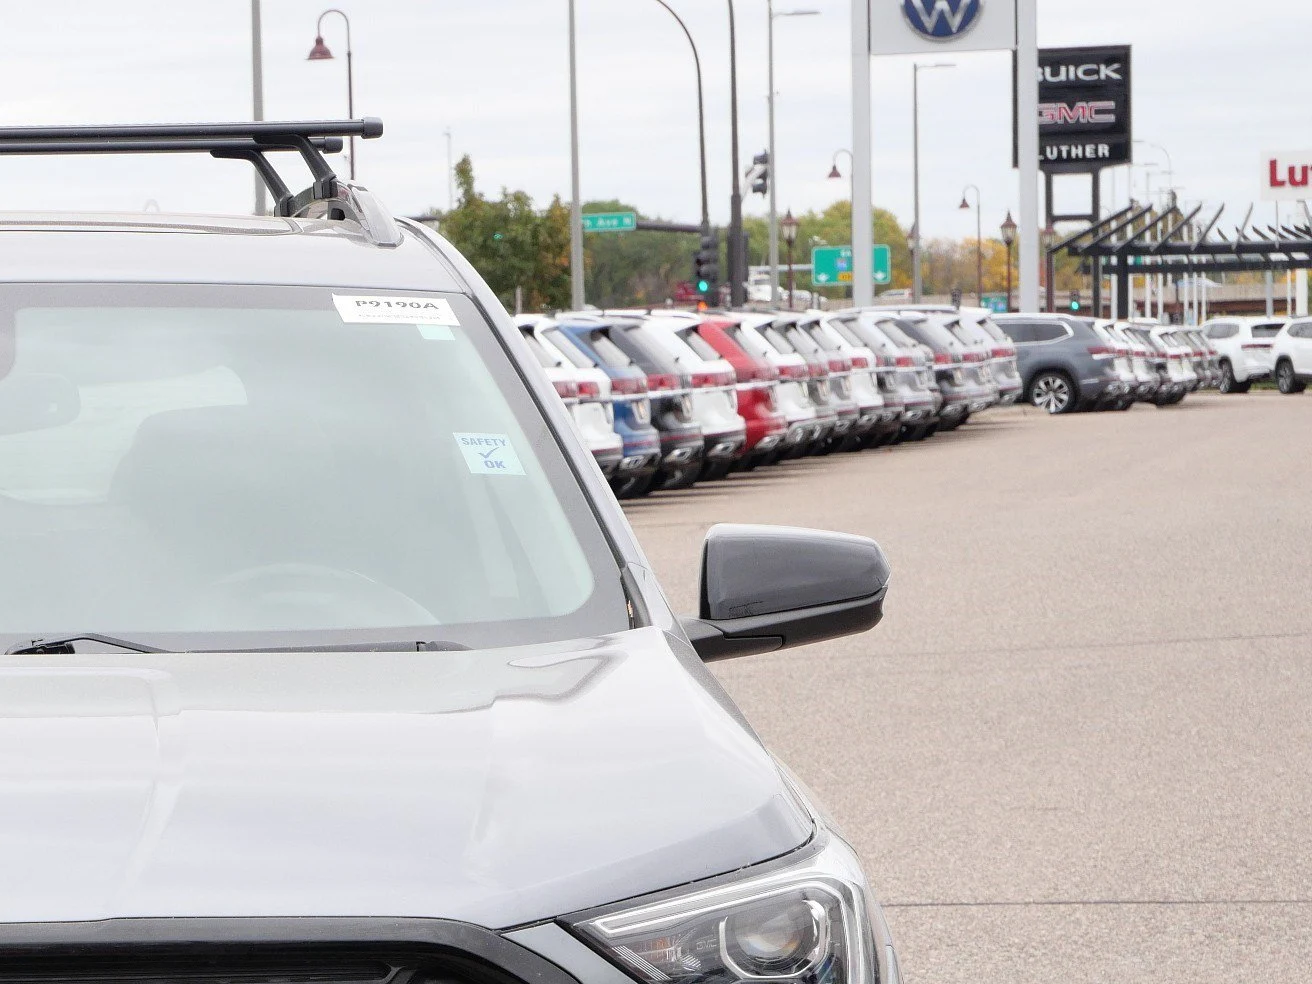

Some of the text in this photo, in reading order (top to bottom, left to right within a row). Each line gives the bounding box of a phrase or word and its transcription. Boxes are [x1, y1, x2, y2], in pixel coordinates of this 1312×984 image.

[1037, 101, 1116, 124] GMC
[1038, 143, 1110, 160] UTHER
[1269, 158, 1312, 187] Lu
[355, 300, 439, 309] P9190A
[461, 437, 507, 446] SAFETY
[484, 460, 506, 469] OK
